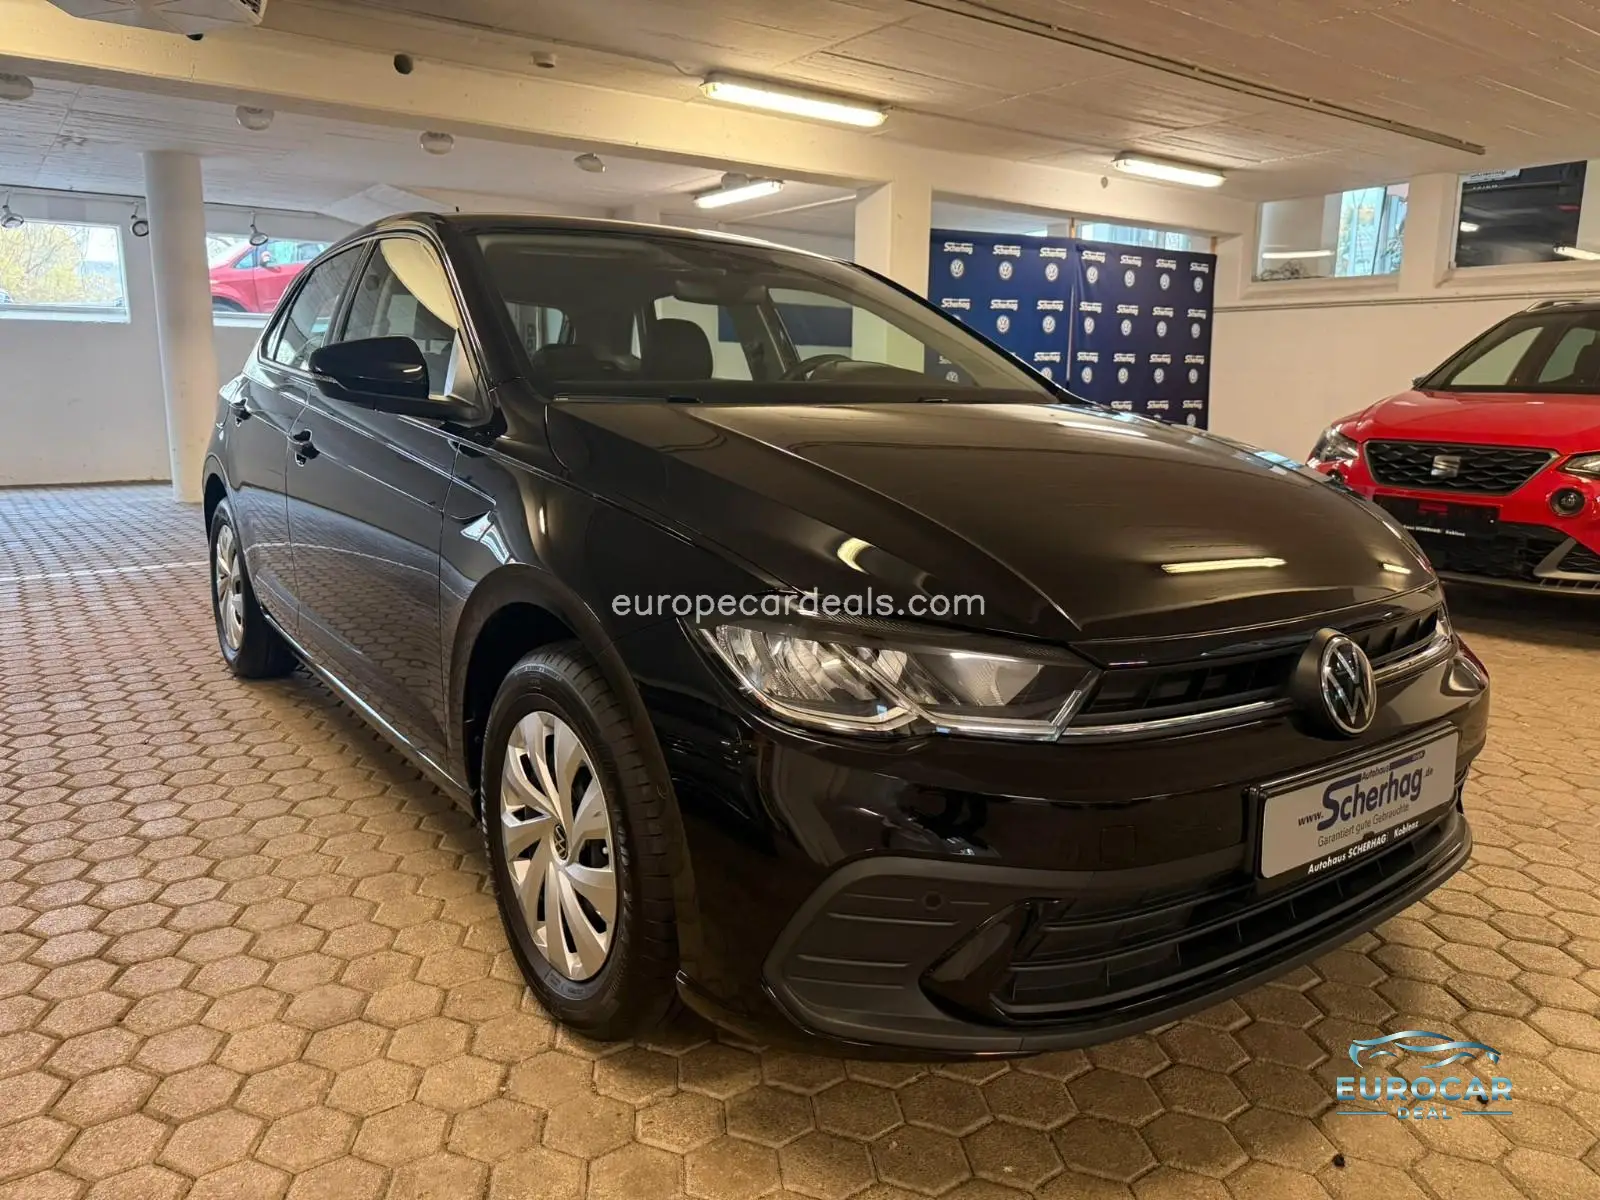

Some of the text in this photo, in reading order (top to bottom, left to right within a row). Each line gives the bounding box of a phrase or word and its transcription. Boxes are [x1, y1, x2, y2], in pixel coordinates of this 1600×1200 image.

[1361, 764, 1391, 779] Autohaus
[1307, 820, 1419, 874] Autohaus SCHERHAG Koblenz
[1318, 827, 1354, 847] Garantiert
[1355, 819, 1371, 835] gute
